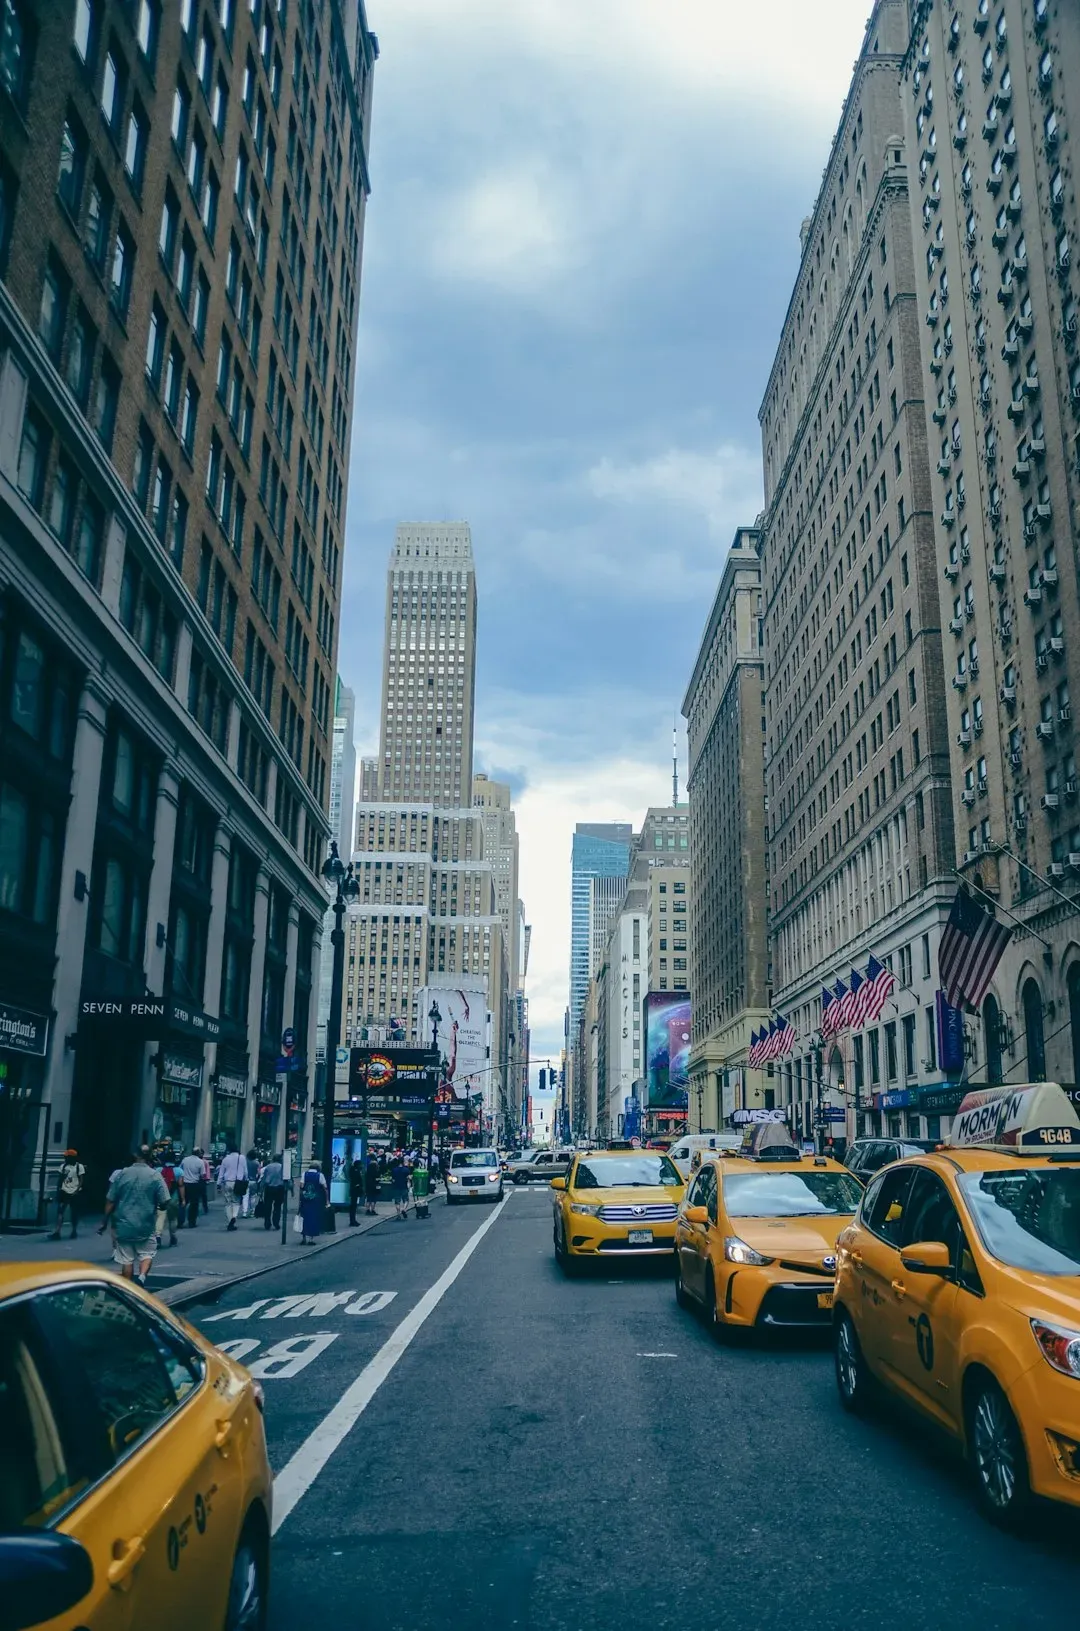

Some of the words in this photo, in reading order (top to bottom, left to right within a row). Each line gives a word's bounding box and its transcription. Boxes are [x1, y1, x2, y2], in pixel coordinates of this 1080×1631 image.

[82, 1002, 122, 1014] SEVEN
[130, 1003, 164, 1015] PENN
[738, 1109, 786, 1122] MSG
[1040, 1129, 1072, 1144] 9G48
[201, 1290, 399, 1322] ONLY
